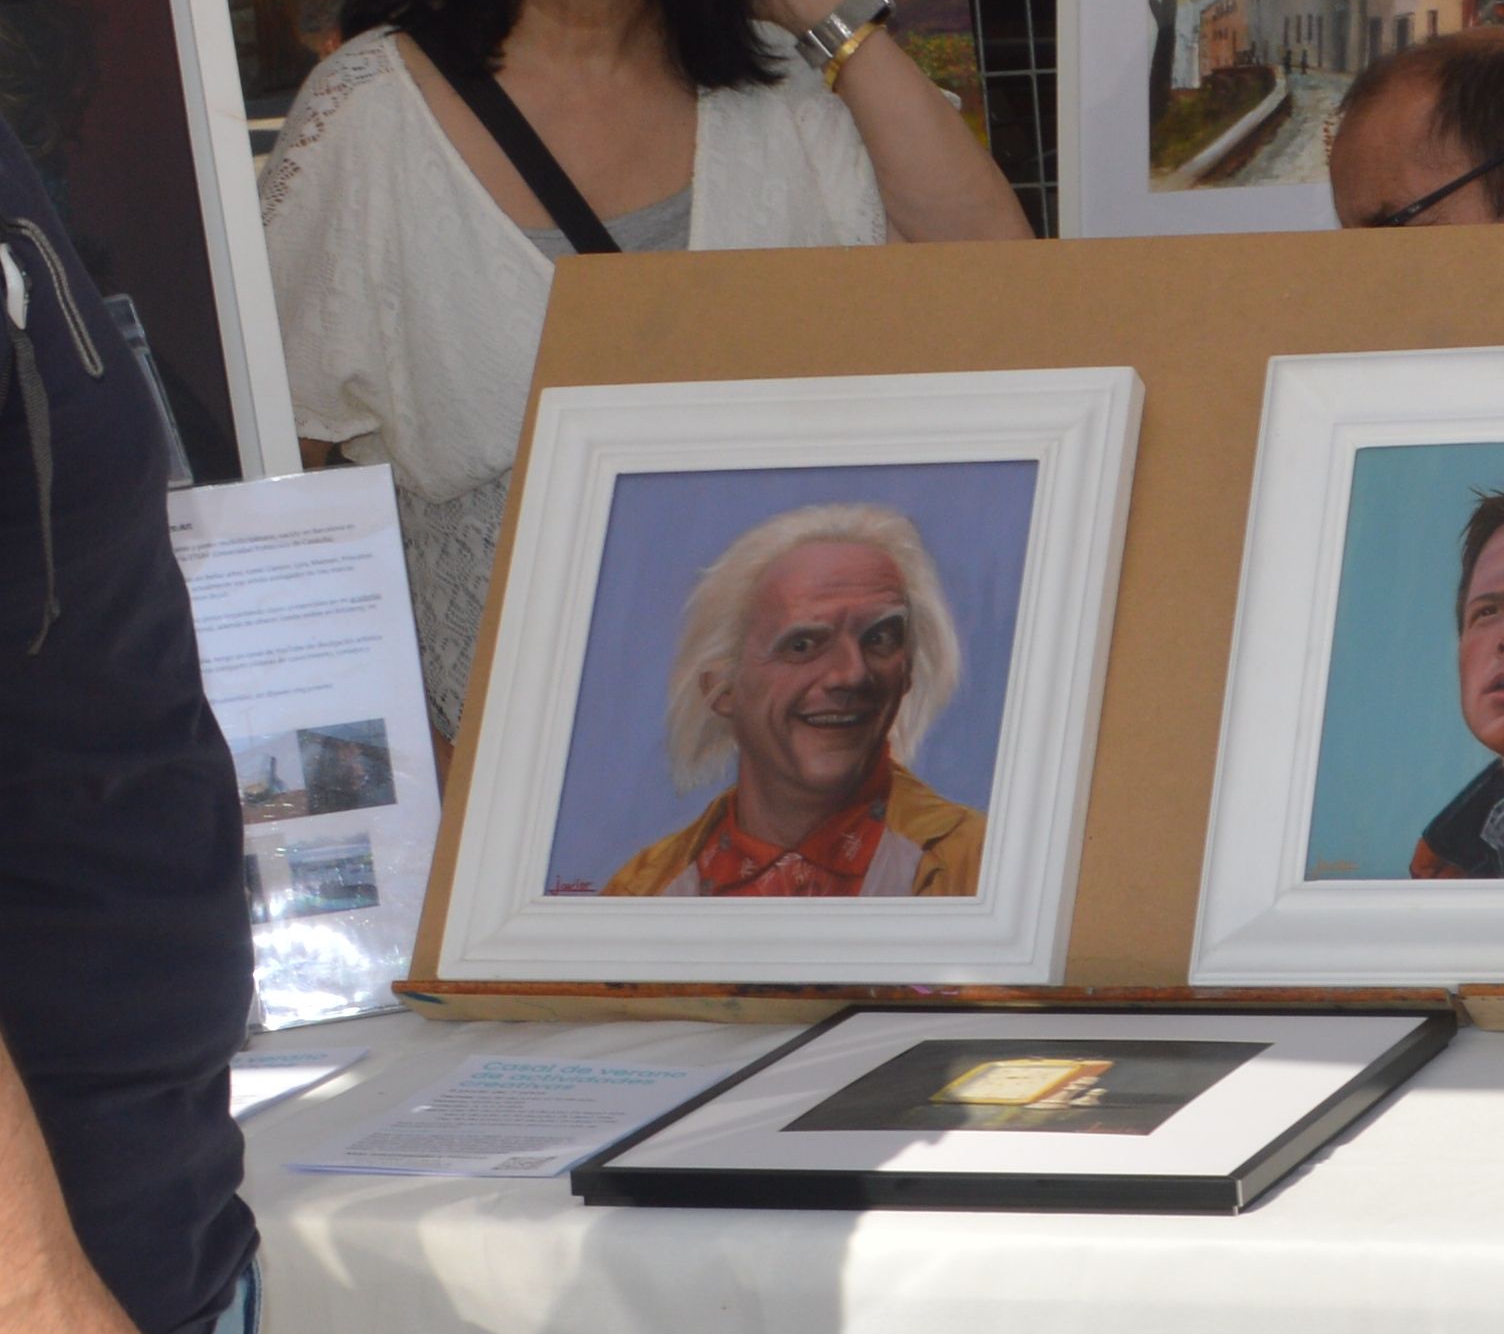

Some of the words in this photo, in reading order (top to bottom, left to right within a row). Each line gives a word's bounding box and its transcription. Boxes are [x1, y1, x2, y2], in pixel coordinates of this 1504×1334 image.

[470, 1070, 503, 1081] de
[482, 1060, 555, 1073] Casal
[559, 1063, 593, 1075] de
[599, 1069, 688, 1079] verano
